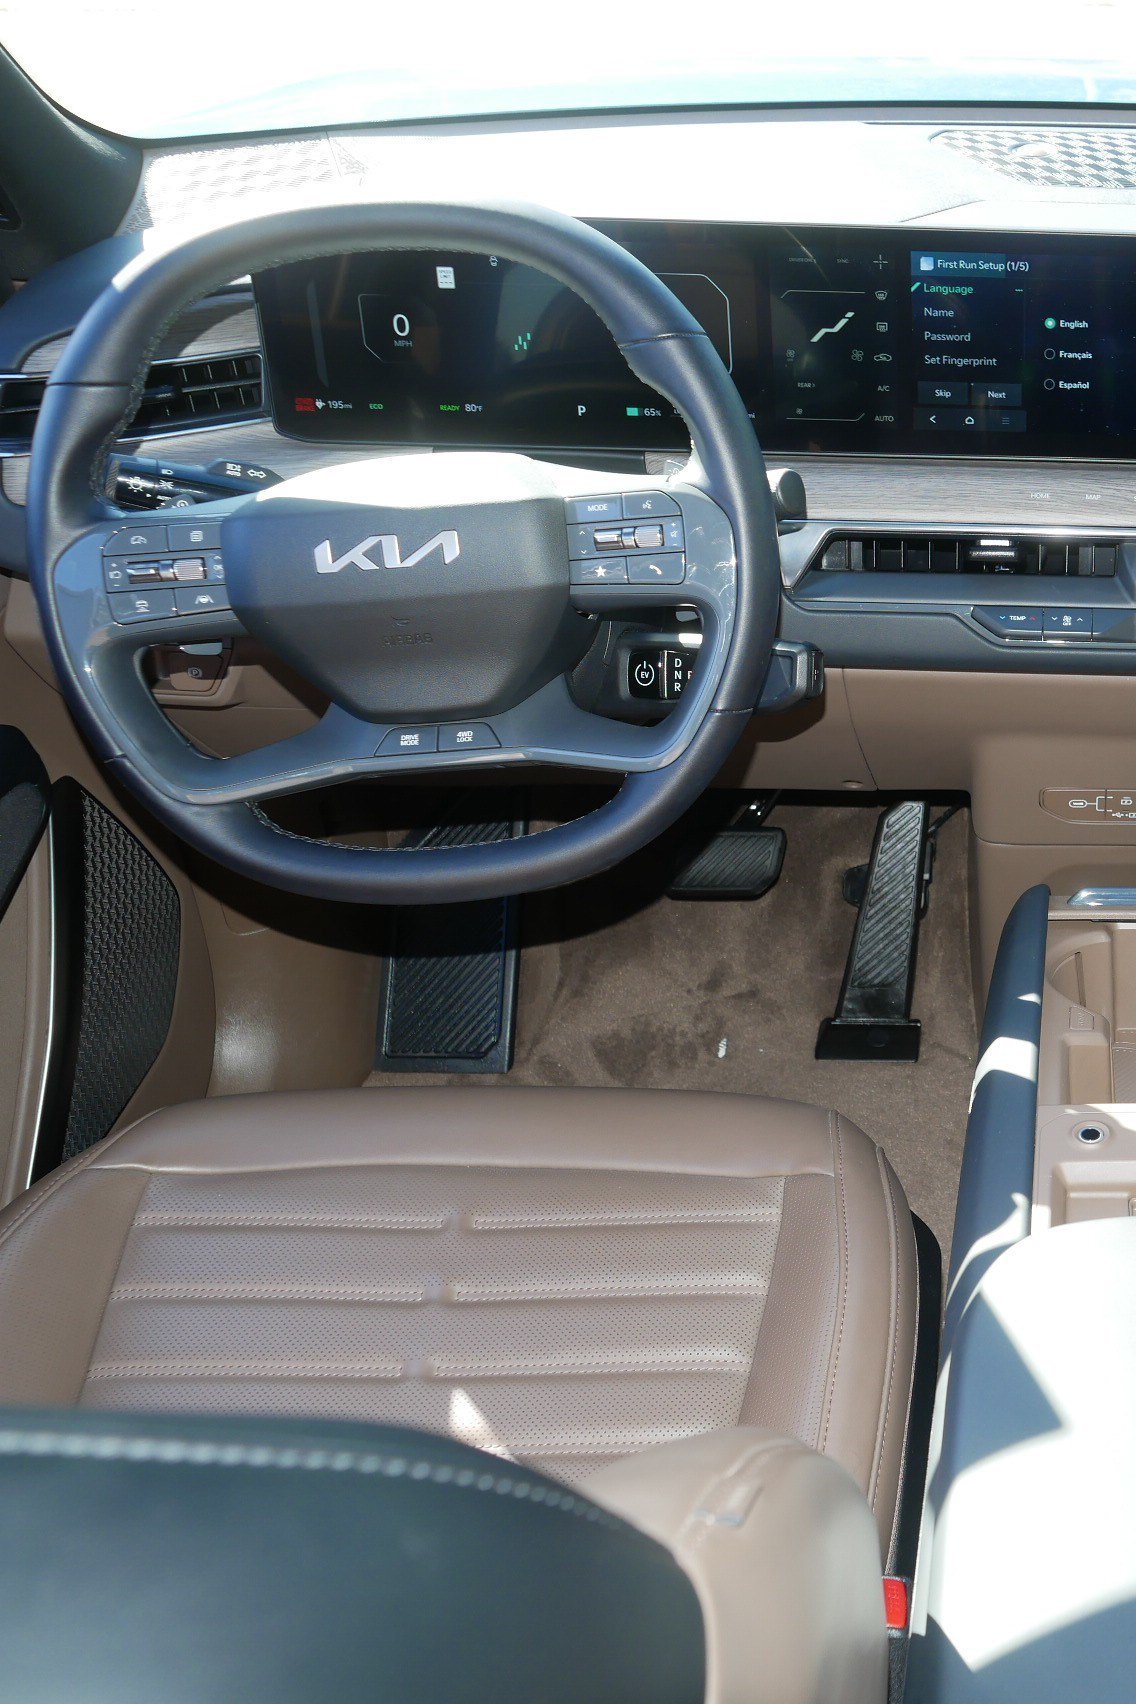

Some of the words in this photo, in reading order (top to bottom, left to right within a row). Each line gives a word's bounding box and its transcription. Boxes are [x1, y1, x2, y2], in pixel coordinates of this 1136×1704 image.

[937, 259, 957, 269] First
[959, 260, 977, 269] Run
[978, 261, 1005, 271] Setup
[1006, 261, 1029, 271] (1/5)
[923, 284, 974, 295] Language
[923, 307, 954, 317] Name
[392, 313, 410, 337] 0
[1060, 320, 1089, 330] English
[924, 331, 971, 342] Password
[924, 355, 941, 365] Set
[942, 356, 997, 367] Fingerprint
[1060, 351, 1093, 361] Français
[1059, 381, 1089, 391] Español
[935, 389, 952, 398] Skip
[987, 391, 1006, 399] Next
[577, 405, 587, 416] P
[643, 408, 662, 417] 65%
[587, 504, 608, 512] MODE
[674, 658, 682, 668] D
[640, 671, 650, 679] EV
[674, 670, 682, 680] N
[674, 682, 682, 692] R
[400, 733, 420, 741] DRIVE
[456, 730, 473, 738] 4WD
